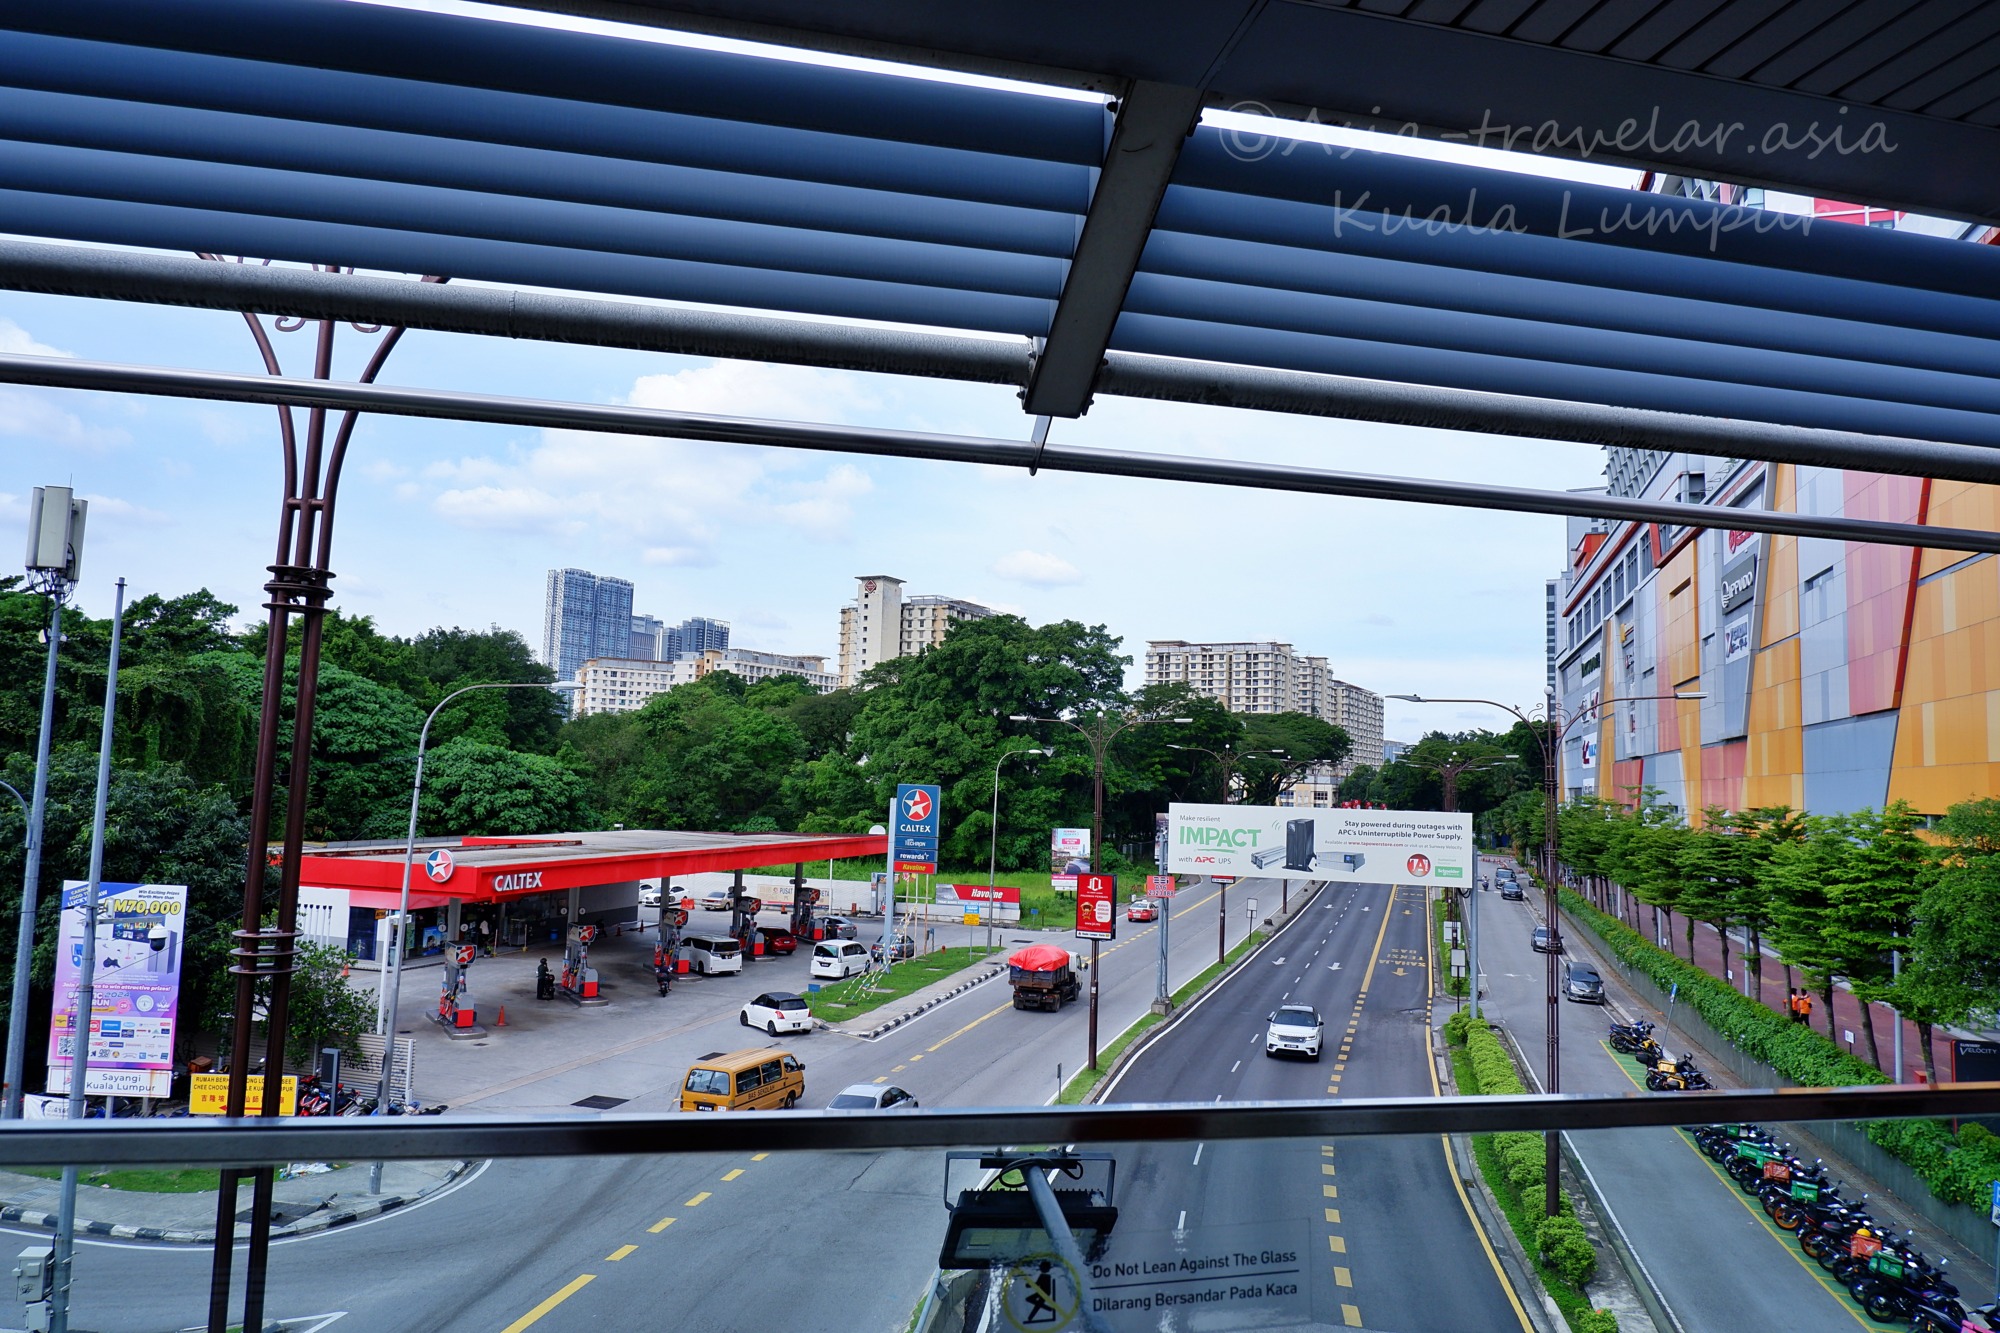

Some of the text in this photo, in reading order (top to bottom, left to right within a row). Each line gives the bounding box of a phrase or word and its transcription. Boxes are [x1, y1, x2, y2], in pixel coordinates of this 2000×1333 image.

[900, 824, 931, 833] CALTEX
[1344, 820, 1359, 828] Stay
[1392, 822, 1416, 830] during
[1180, 826, 1261, 847] IMPACT
[1358, 830, 1412, 838] Uninterruptible
[1413, 831, 1435, 839] Power
[1436, 832, 1463, 841] Supply.
[494, 871, 543, 892] CALTEX
[1960, 1047, 1997, 1056] VELOCITY
[102, 1073, 141, 1082] Sayangi
[86, 1082, 156, 1093] Kuala Lumpur
[748, 1085, 775, 1100] BAS SEKOLAH
[1801, 1191, 1814, 1199] Grab
[1093, 1251, 1297, 1278] Do Not Lean Against The Glass
[1093, 1283, 1298, 1312] Dilarang Bersandar Pada Kaca
